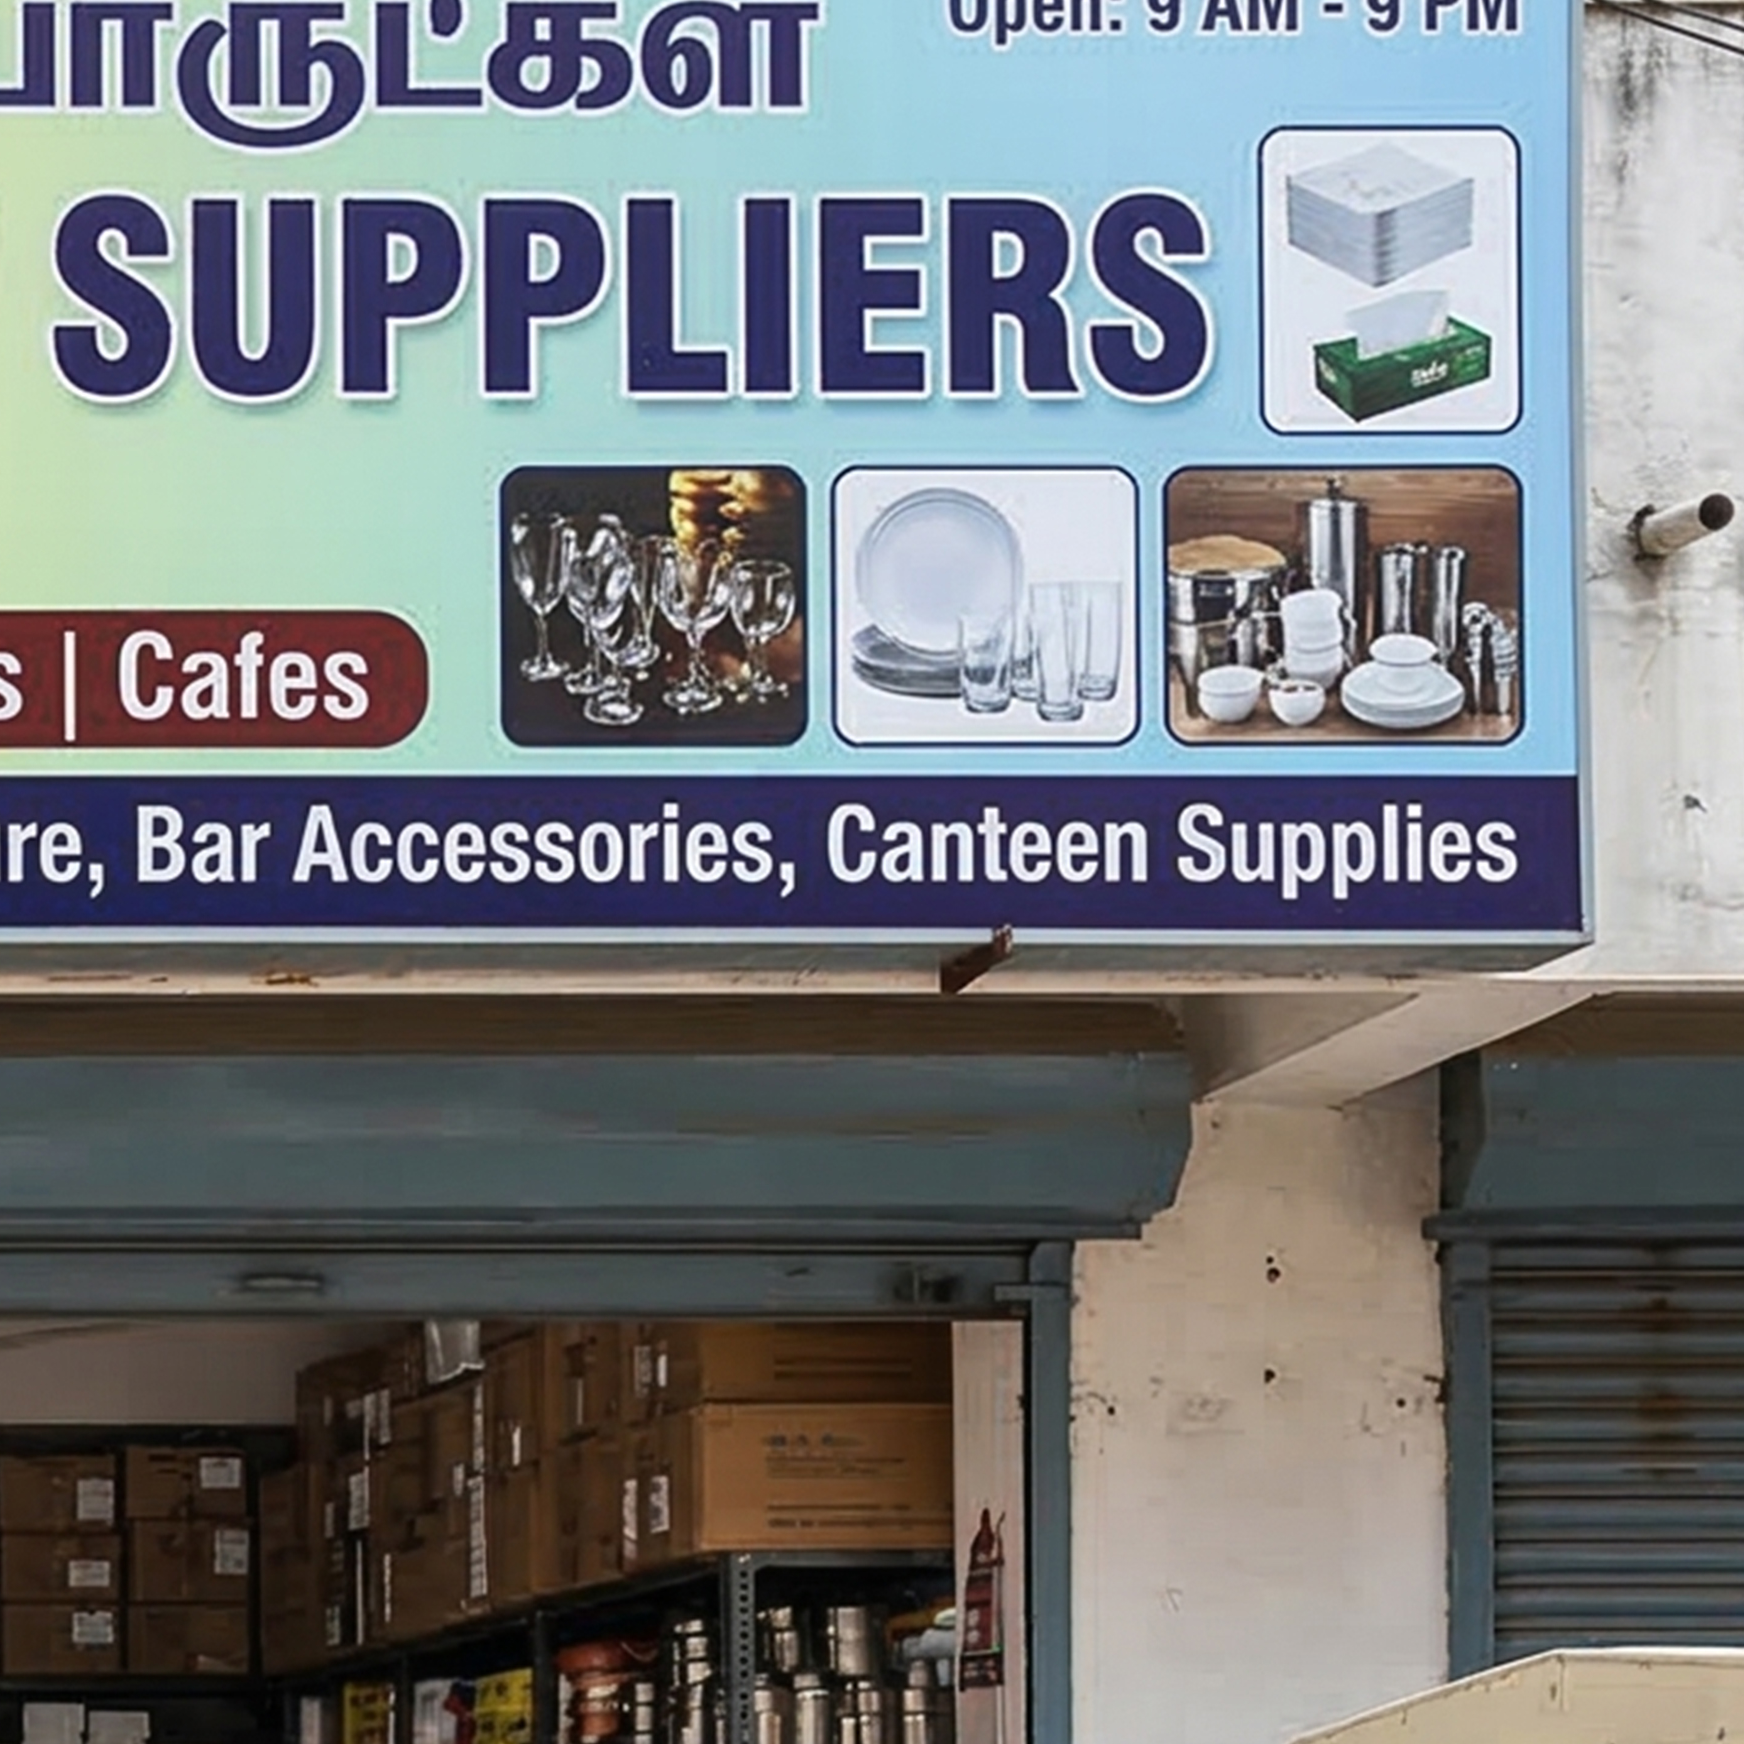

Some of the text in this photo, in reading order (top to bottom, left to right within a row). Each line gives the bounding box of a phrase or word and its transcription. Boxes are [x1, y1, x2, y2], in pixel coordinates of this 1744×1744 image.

[54, 193, 1208, 398] SUPPLIERS
[118, 630, 370, 720] Cafes
[137, 804, 271, 884] Bar
[292, 802, 795, 898] Accessories,
[827, 803, 1148, 883] Canteen
[1177, 803, 1518, 900] Supplies
